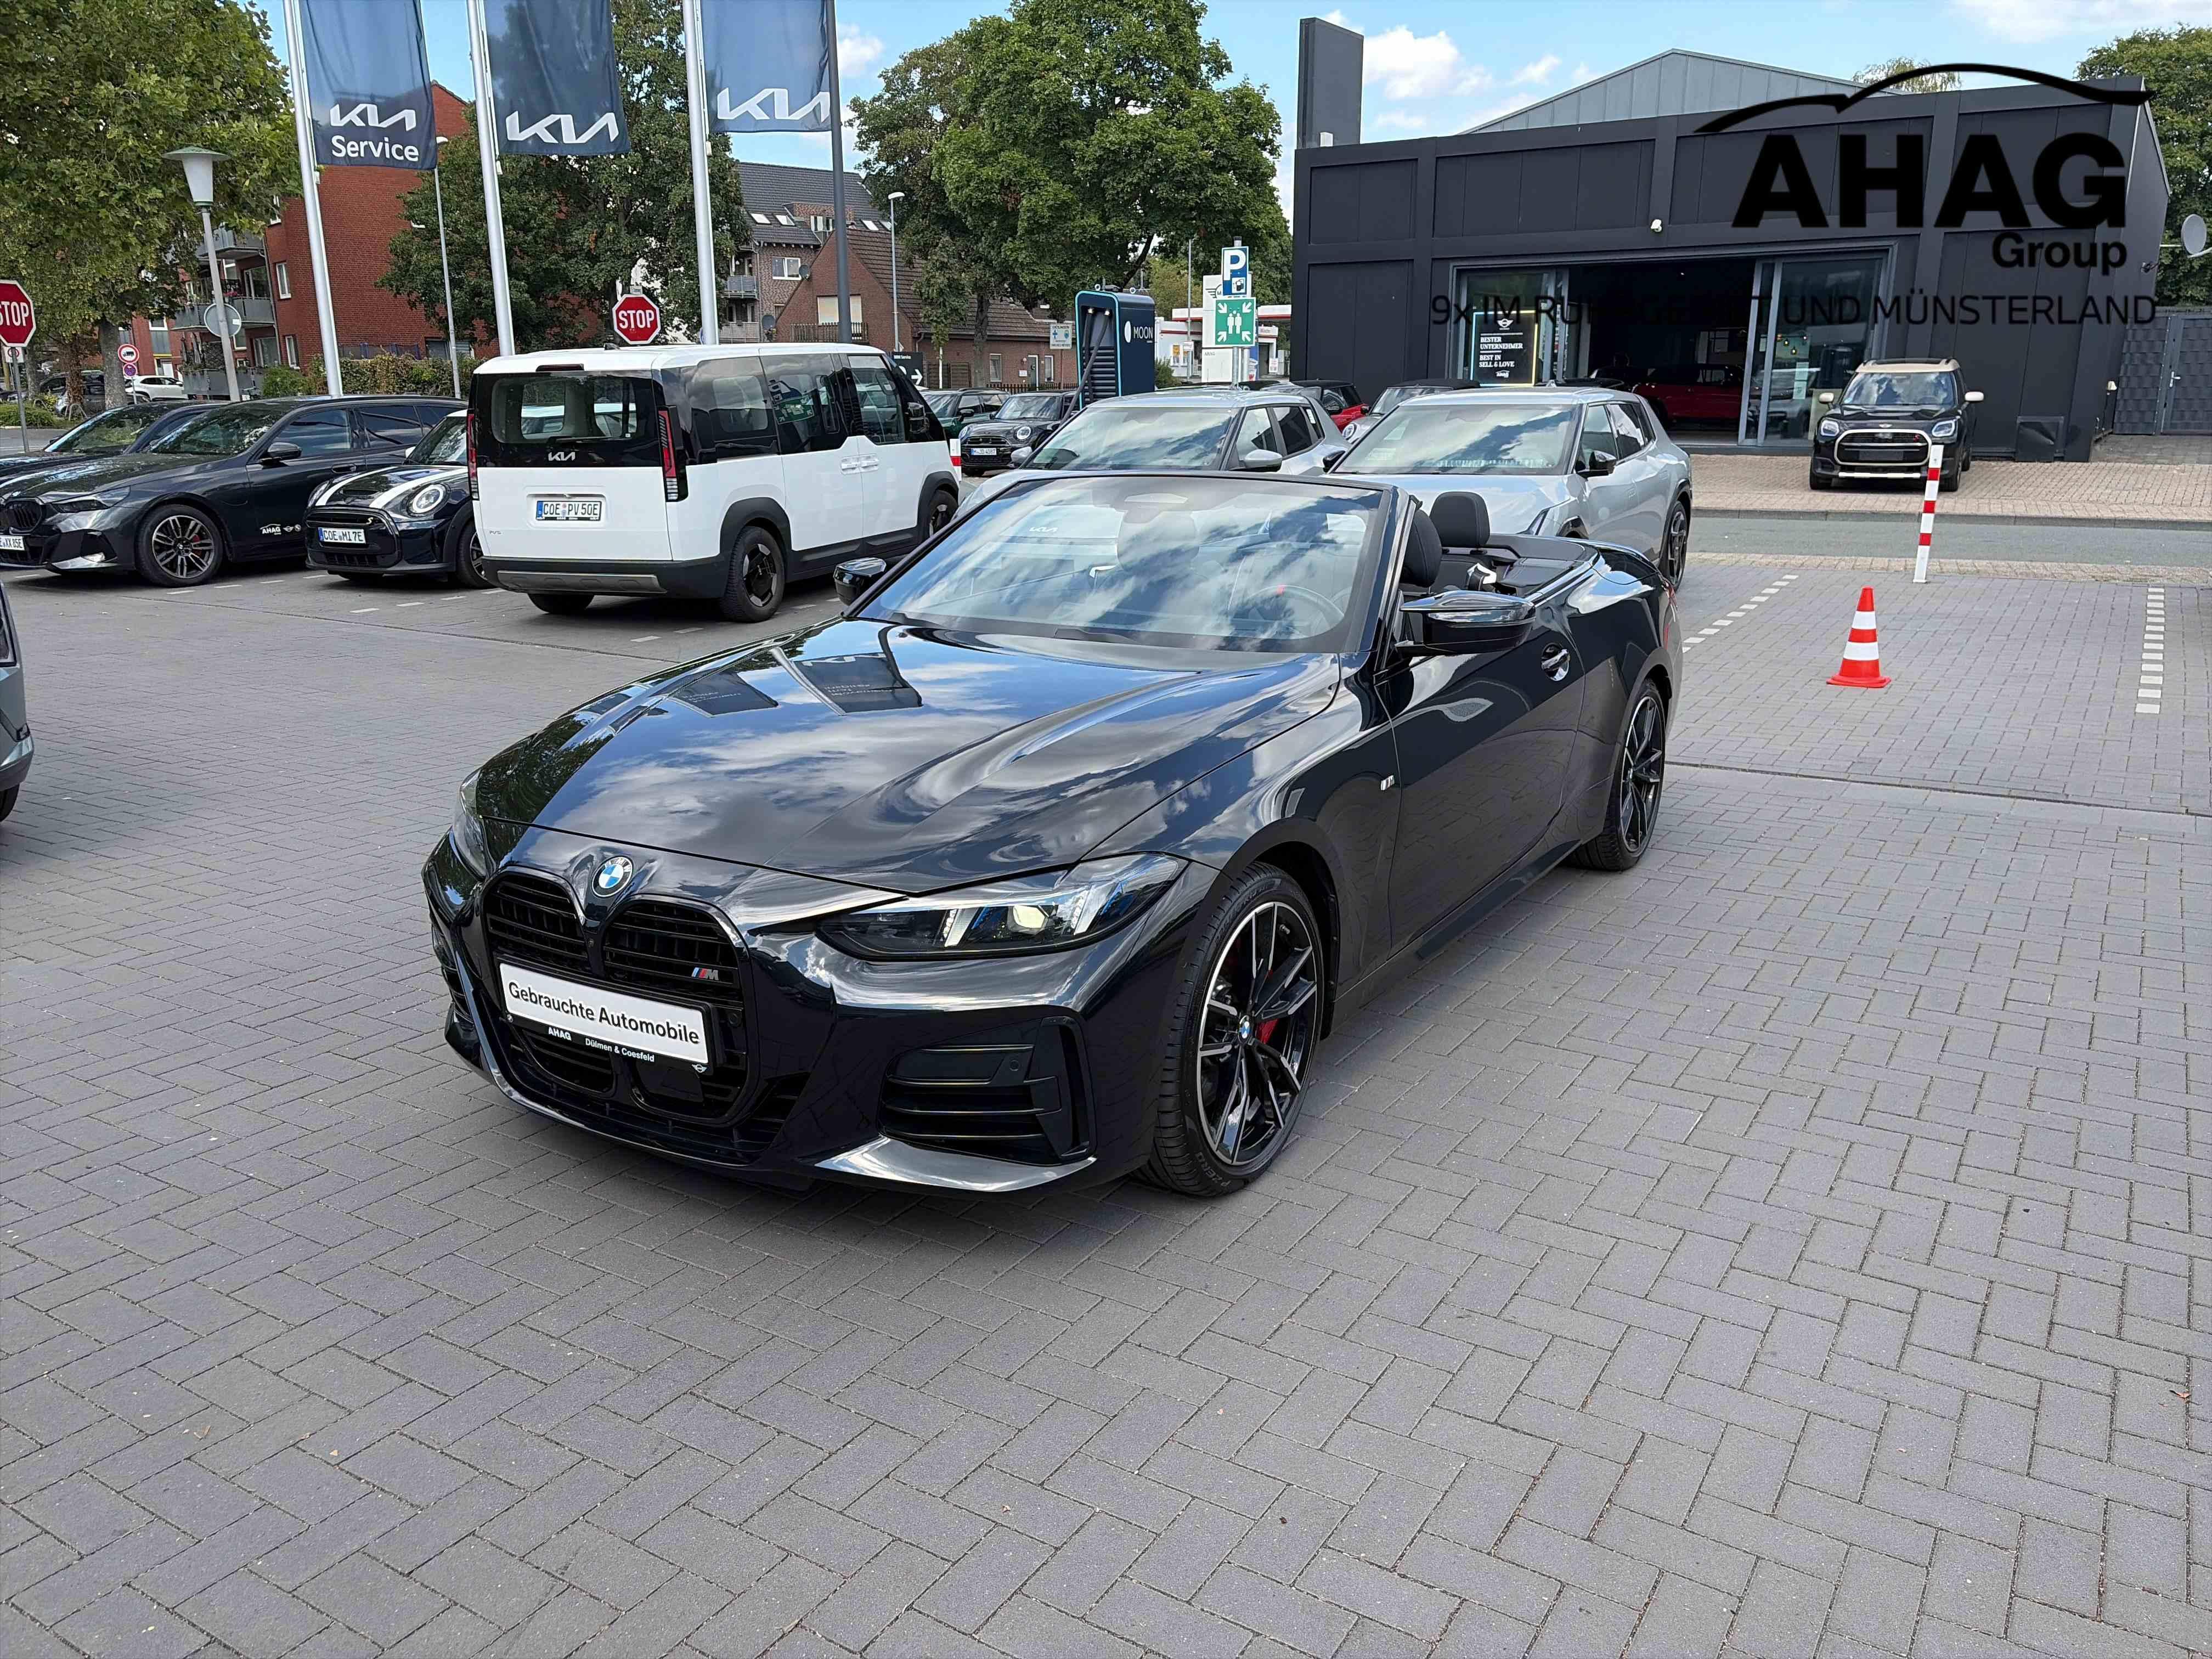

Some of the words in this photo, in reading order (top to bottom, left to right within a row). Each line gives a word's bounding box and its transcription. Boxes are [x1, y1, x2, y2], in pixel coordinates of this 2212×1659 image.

[717, 87, 831, 121] KIA
[330, 103, 416, 132] KIA
[505, 111, 619, 144] KIA
[331, 135, 419, 161] Service
[618, 309, 654, 329] STOP
[1133, 326, 1153, 339] MOON
[548, 452, 575, 461] KIA
[543, 504, 560, 515] COE
[568, 504, 580, 515] PV
[324, 530, 338, 540] COE
[509, 981, 595, 1021] Gebrauchte
[599, 1007, 699, 1044] Automobile
[549, 1026, 572, 1041] AHAG
[585, 1038, 612, 1052] Dülmen
[614, 1046, 620, 1054] &
[621, 1047, 654, 1063] Coesfeld
